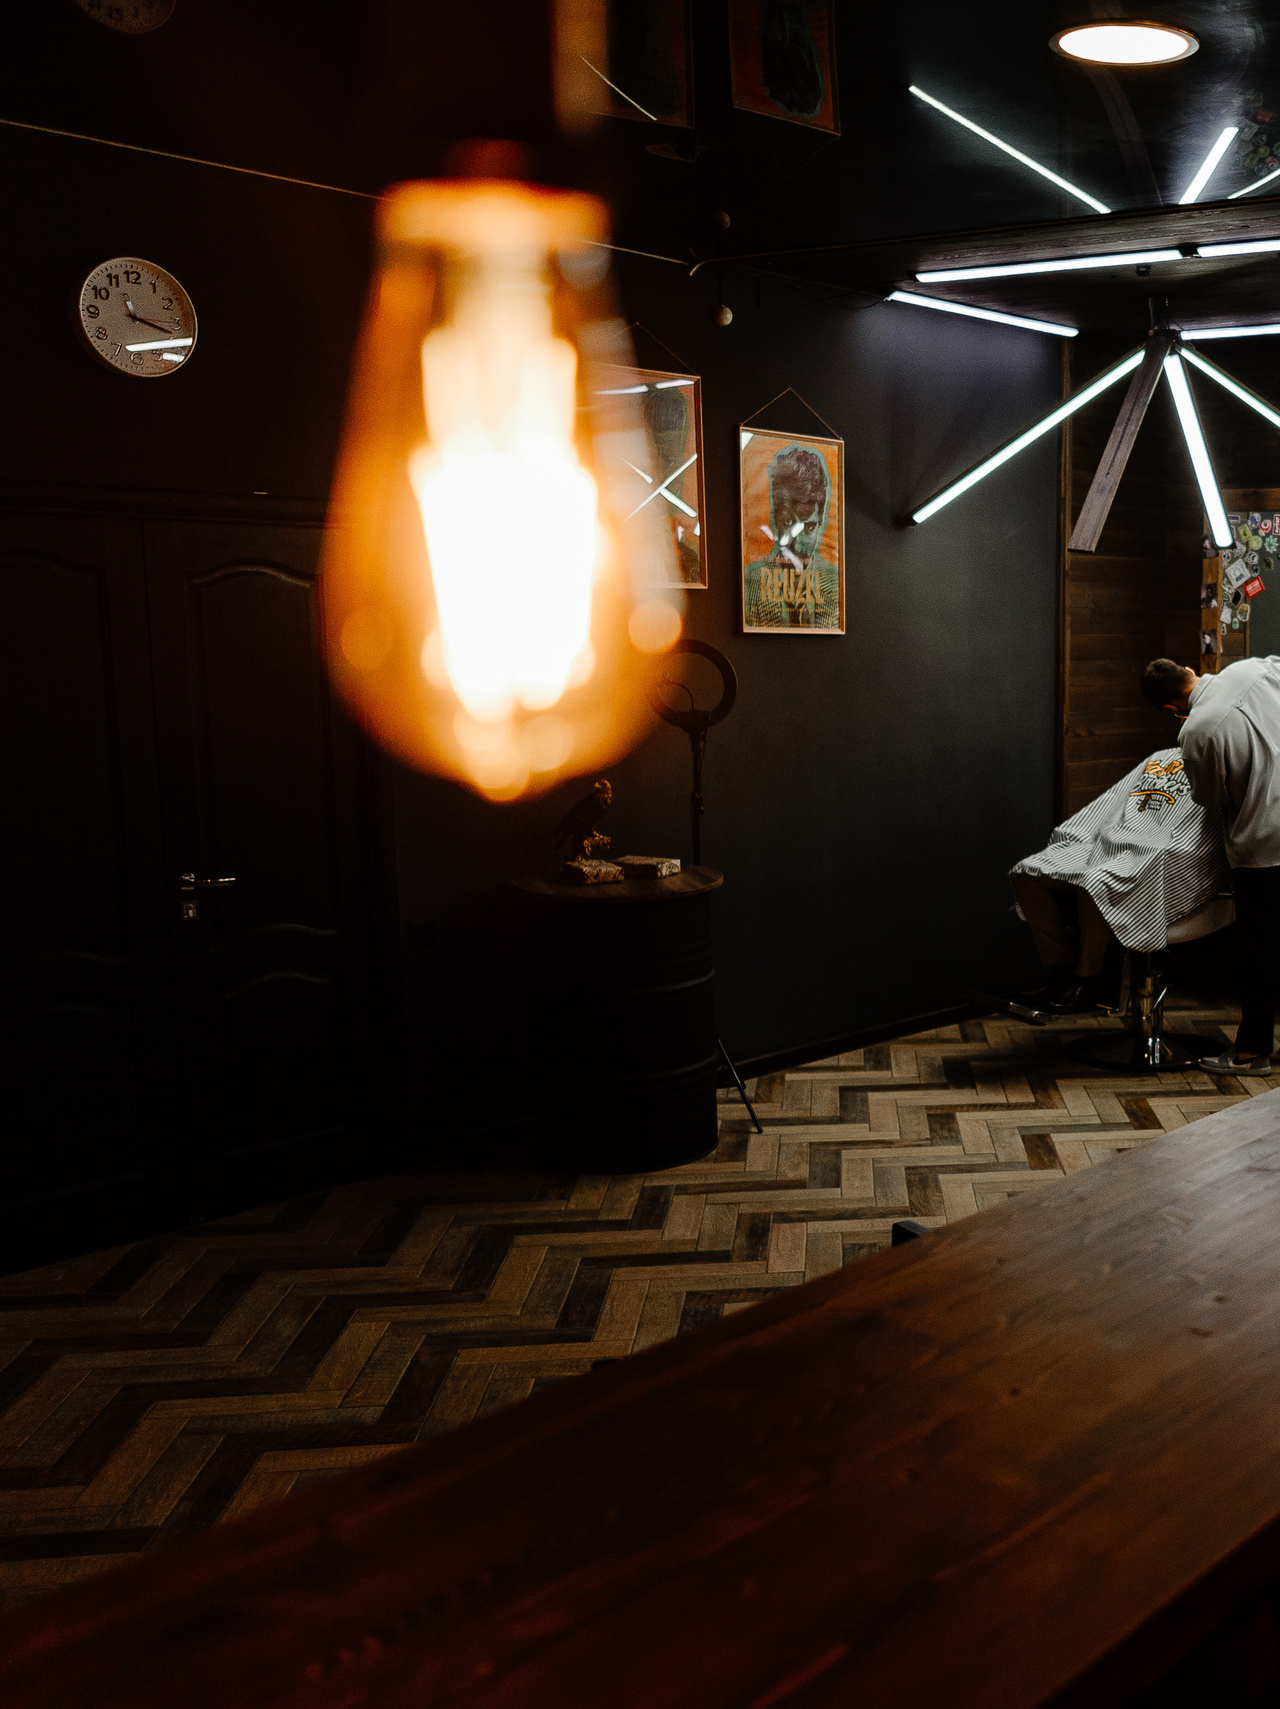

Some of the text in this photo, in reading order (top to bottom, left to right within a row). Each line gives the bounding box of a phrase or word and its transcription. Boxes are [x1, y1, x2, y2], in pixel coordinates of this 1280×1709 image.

[106, 273, 120, 288] 11
[123, 270, 142, 286] 12
[91, 285, 110, 301] 10
[150, 280, 157, 294] 1
[86, 304, 100, 319] 9
[162, 297, 174, 312] 2
[171, 317, 181, 331] 3
[95, 326, 108, 341] 8
[111, 341, 123, 356] 7
[130, 351, 144, 366] 6
[760, 567, 825, 604] REUZEL
